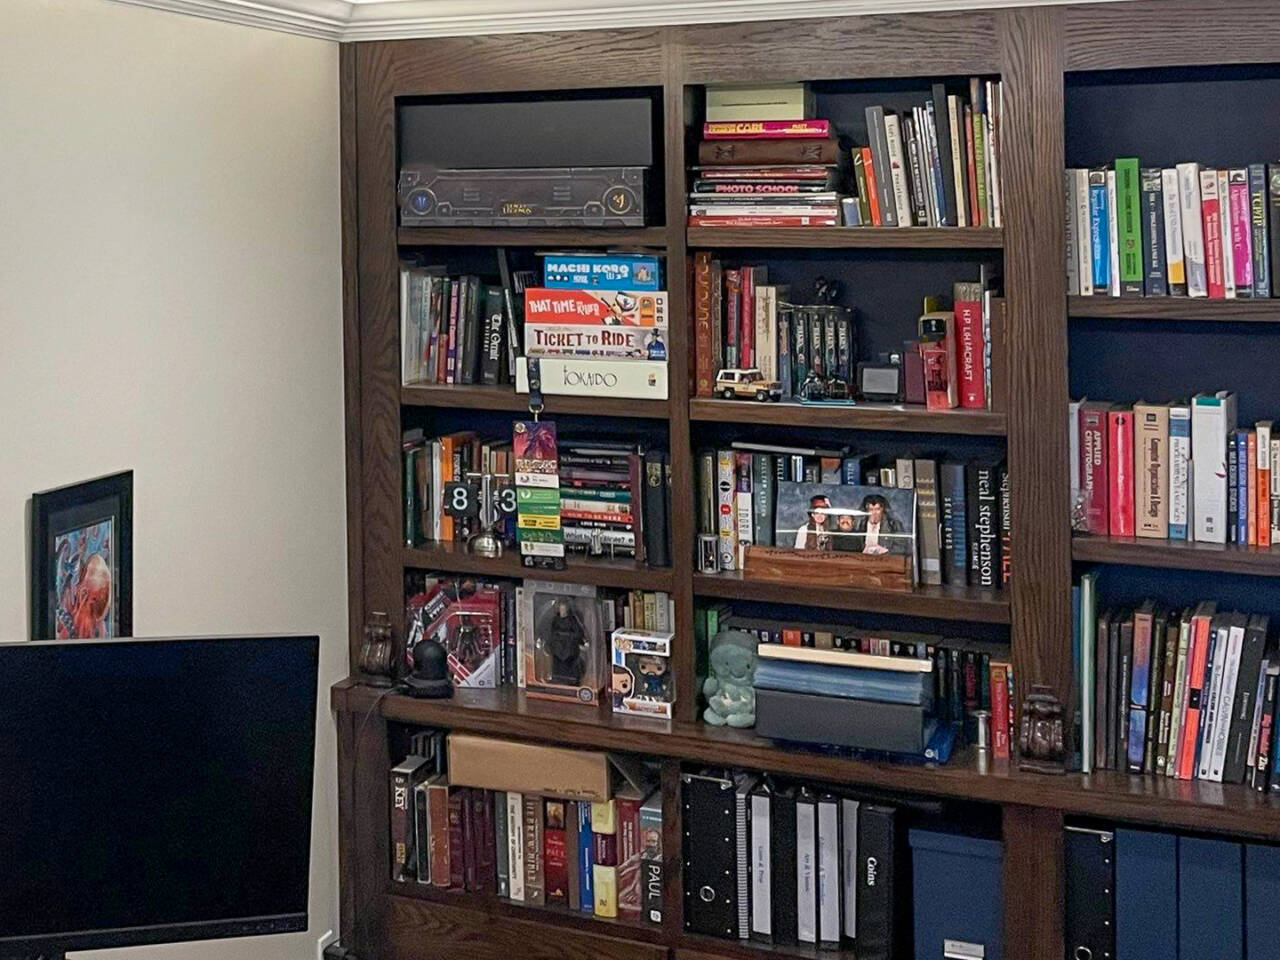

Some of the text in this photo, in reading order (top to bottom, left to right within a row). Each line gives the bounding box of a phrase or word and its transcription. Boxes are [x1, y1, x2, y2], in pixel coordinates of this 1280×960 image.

[715, 184, 799, 193] PHOTO SCHOOL
[1091, 189, 1100, 216] Regular
[1252, 191, 1262, 227] TCP/IP
[1234, 226, 1242, 242] with
[547, 263, 629, 274] MACHI KORO
[529, 299, 576, 314] THAT TIME
[533, 329, 635, 348] TICKET TO RIDE
[563, 364, 618, 387] TOKAIDO
[1093, 430, 1102, 466] APPLIED
[847, 462, 855, 485] WILLI
[452, 487, 468, 511] 8
[500, 488, 517, 513] 3
[739, 508, 749, 534] IDORU
[975, 470, 997, 586] neal stephenson
[1220, 696, 1231, 721] CALVIN
[395, 786, 406, 810] KEY
[526, 801, 537, 883] HEBREW BIBLE
[648, 864, 661, 900] PAUL
[867, 856, 878, 887] Coins
